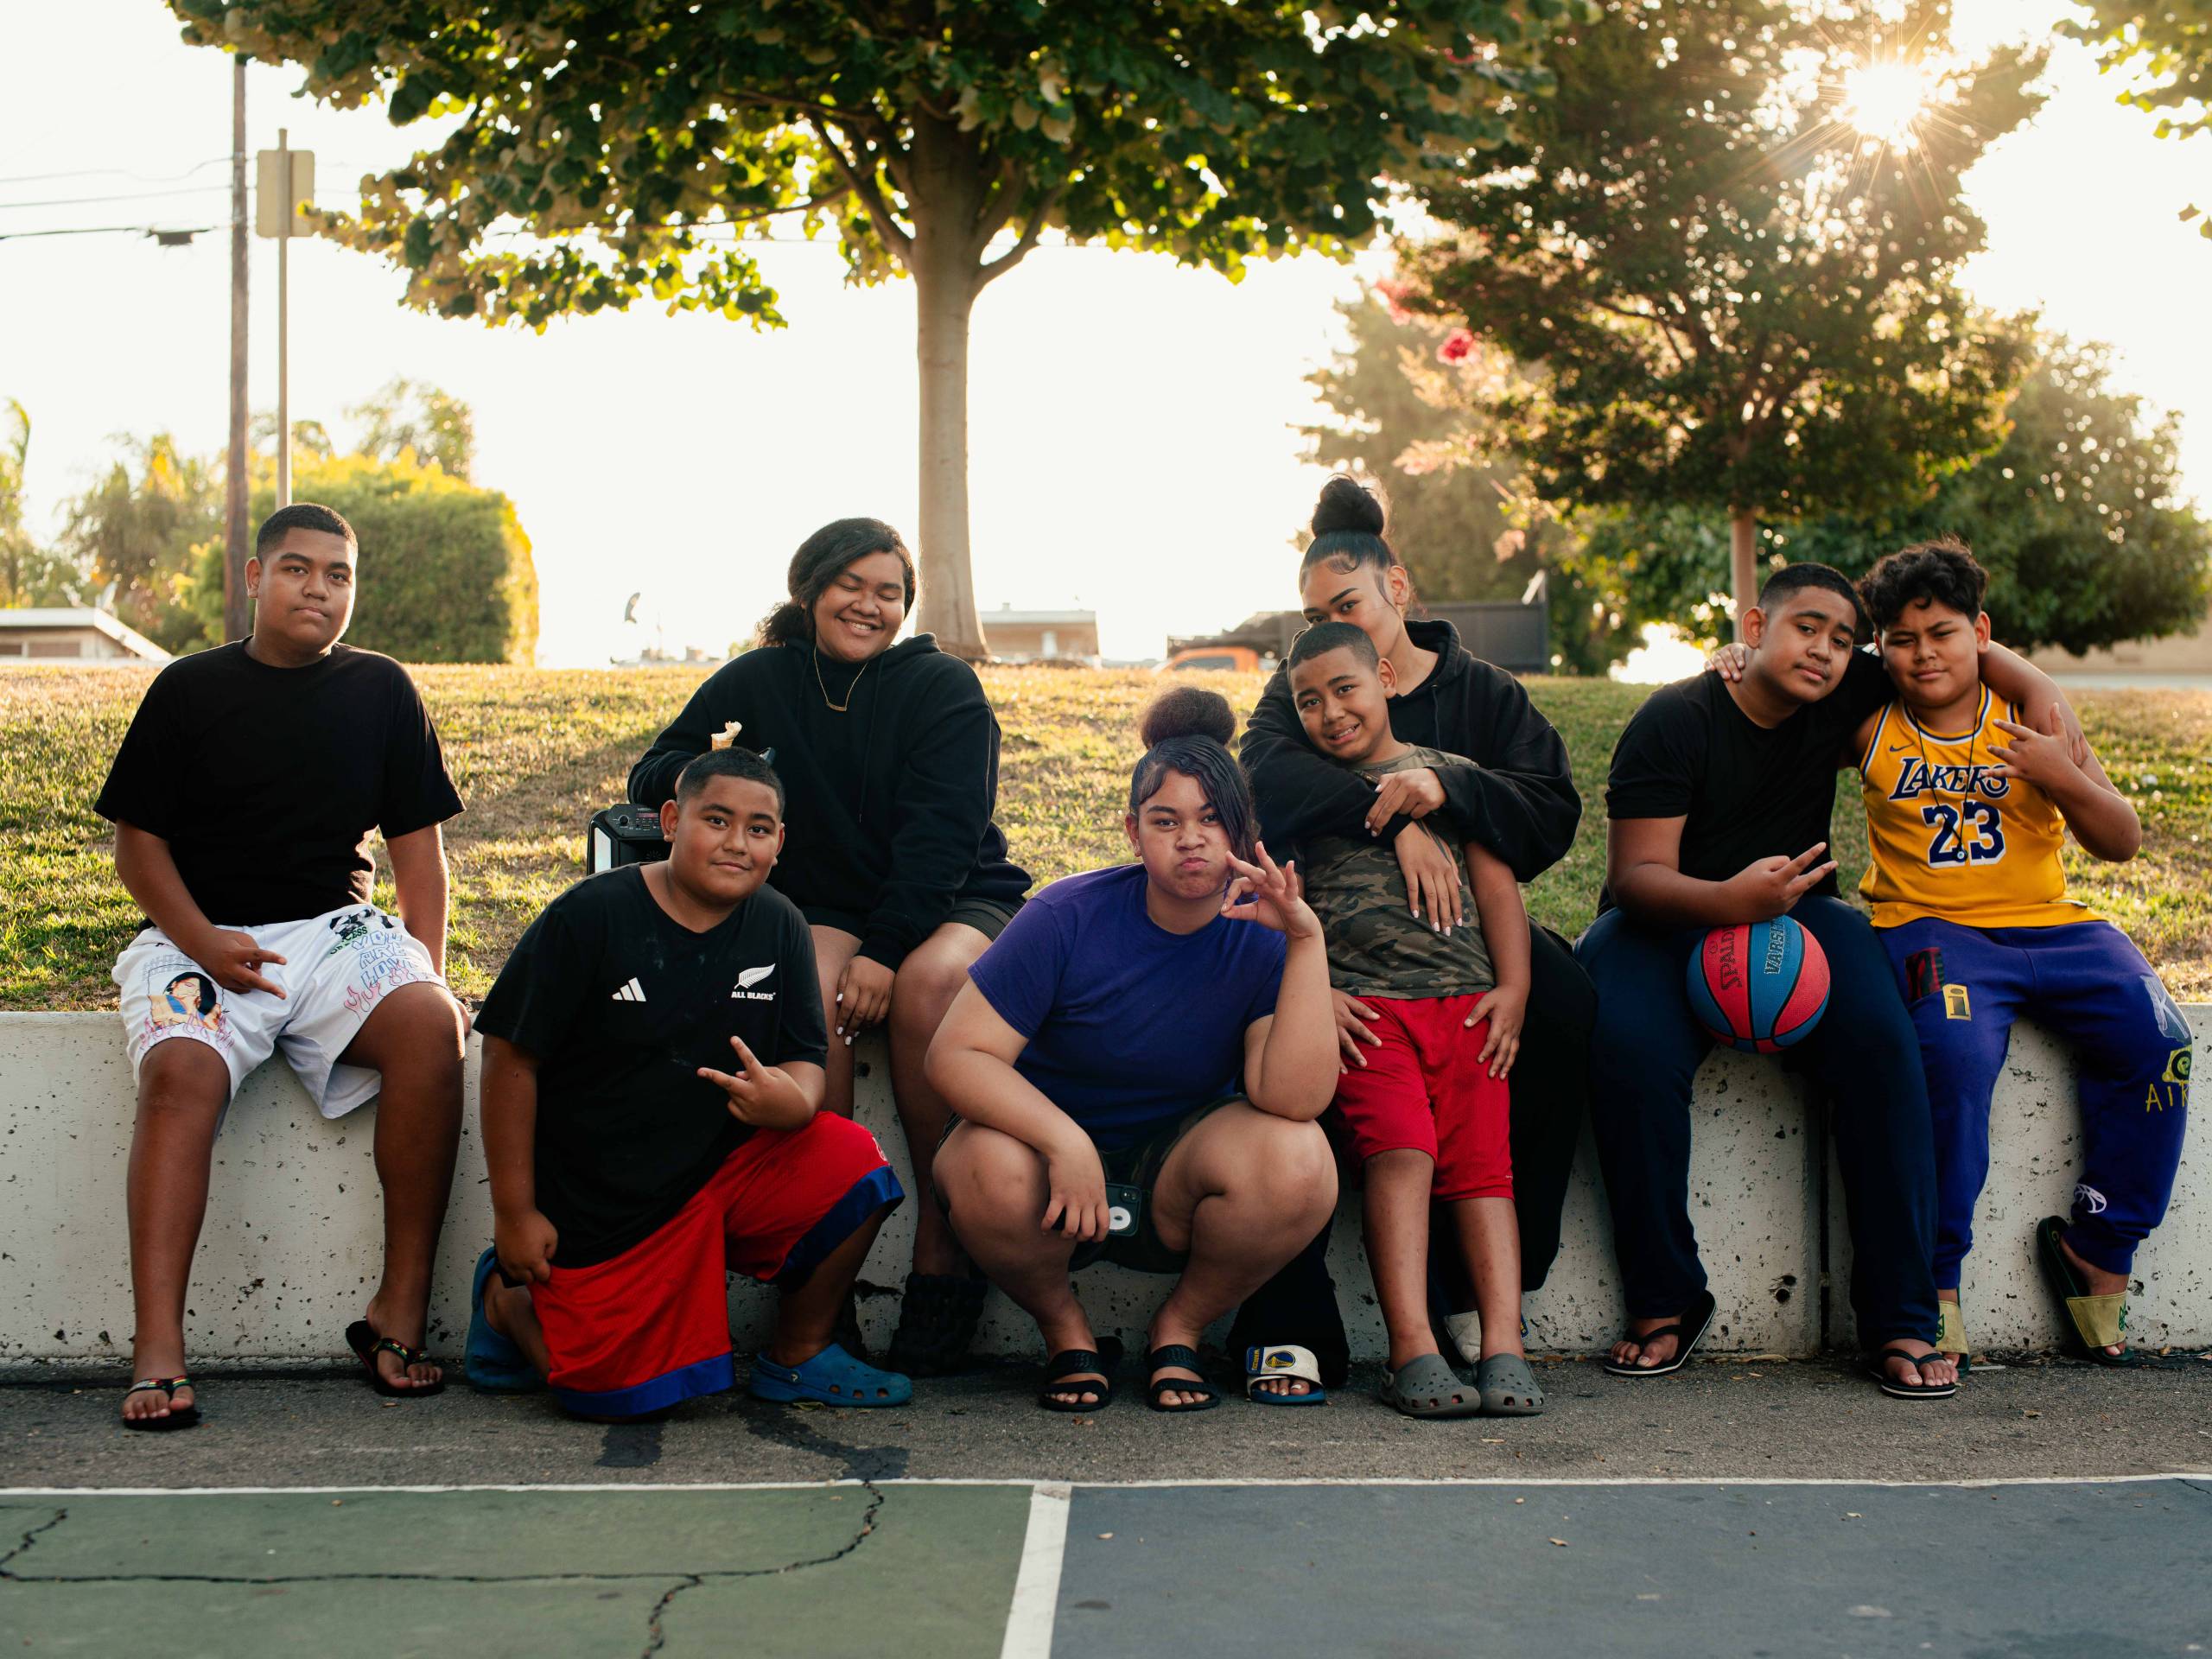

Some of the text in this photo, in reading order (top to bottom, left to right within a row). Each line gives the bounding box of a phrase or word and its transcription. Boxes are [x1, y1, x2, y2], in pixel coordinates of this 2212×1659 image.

[1888, 757, 2010, 801] LAKERS
[1922, 799, 2005, 868] 23
[351, 931, 402, 950] YOU
[359, 942, 407, 969] ARE
[1719, 928, 1742, 991] SPALD
[747, 992, 773, 1001] BLACKS
